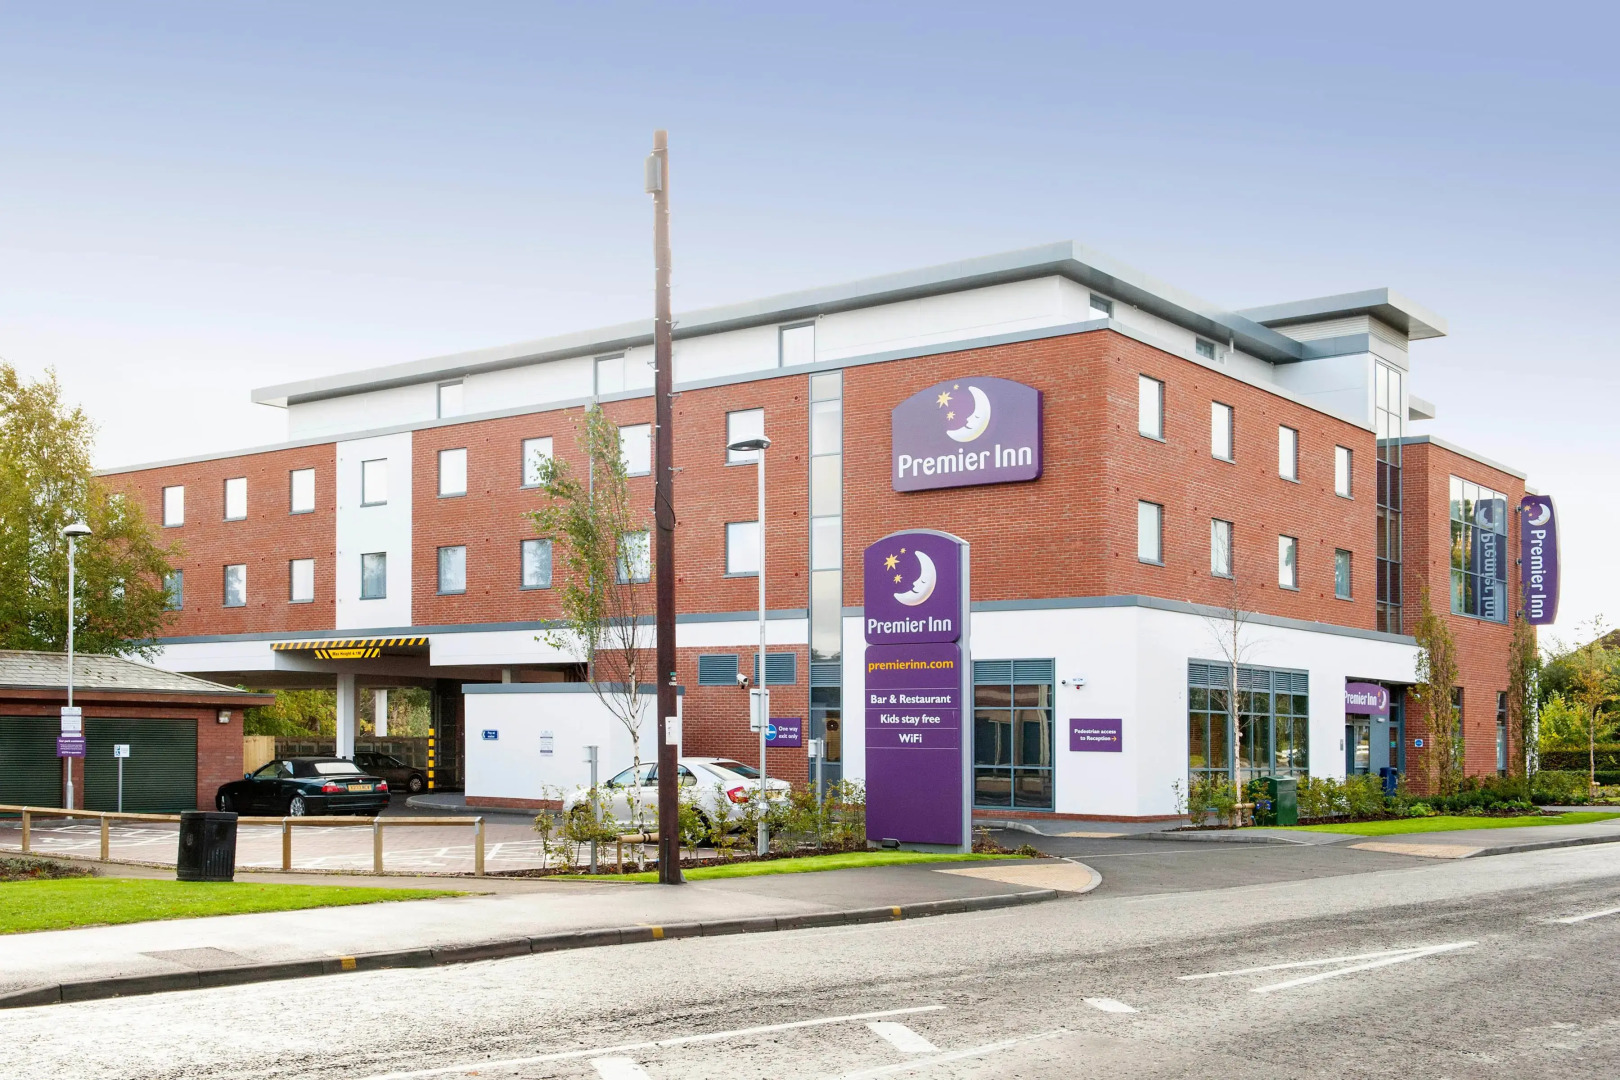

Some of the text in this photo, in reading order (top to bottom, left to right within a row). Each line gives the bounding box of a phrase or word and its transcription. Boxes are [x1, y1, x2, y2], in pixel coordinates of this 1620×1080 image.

[898, 444, 1031, 478] Premier Inn
[1530, 530, 1546, 618] Premier Inn
[868, 616, 952, 634] Premier Inn
[868, 659, 954, 673] premierinn.com
[870, 694, 951, 704] Bar & Restaurant
[1345, 690, 1377, 706] Premier Inn
[880, 714, 941, 726] Kids stay free
[788, 733, 798, 741] only
[899, 733, 922, 743] WiFi
